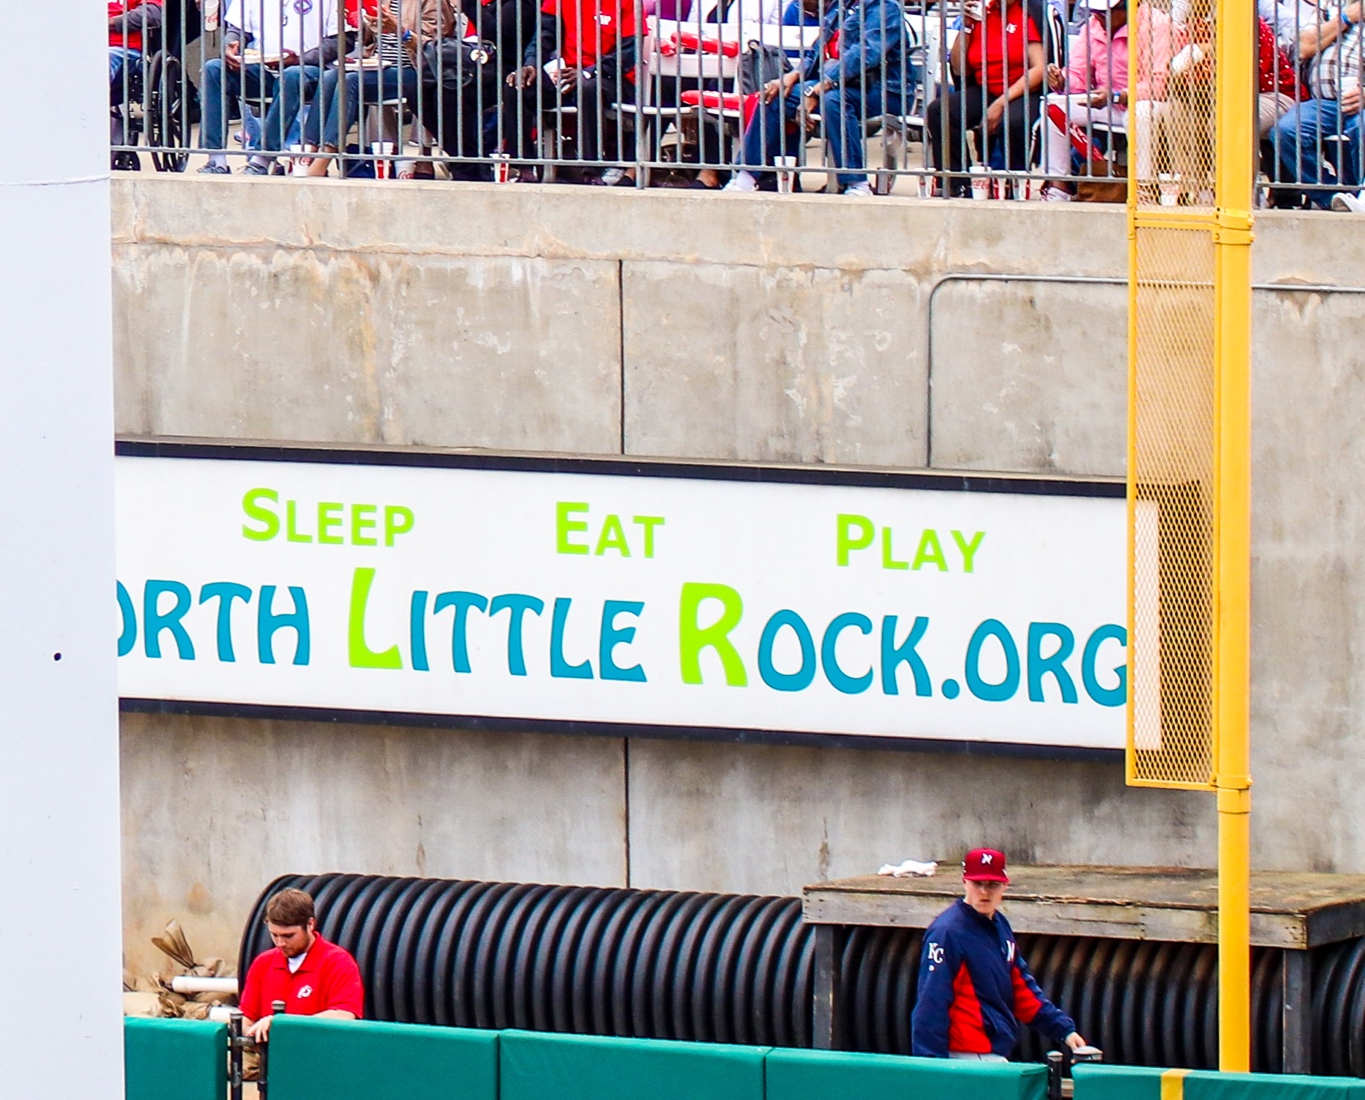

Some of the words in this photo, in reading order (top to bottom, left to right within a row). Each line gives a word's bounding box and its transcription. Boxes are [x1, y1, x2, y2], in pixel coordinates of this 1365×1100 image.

[240, 487, 415, 548] SLEEP
[554, 501, 667, 560] EAT
[835, 513, 987, 574] PLAY
[347, 567, 648, 684] LITTLE
[678, 581, 1127, 708] ROCK.ORG
